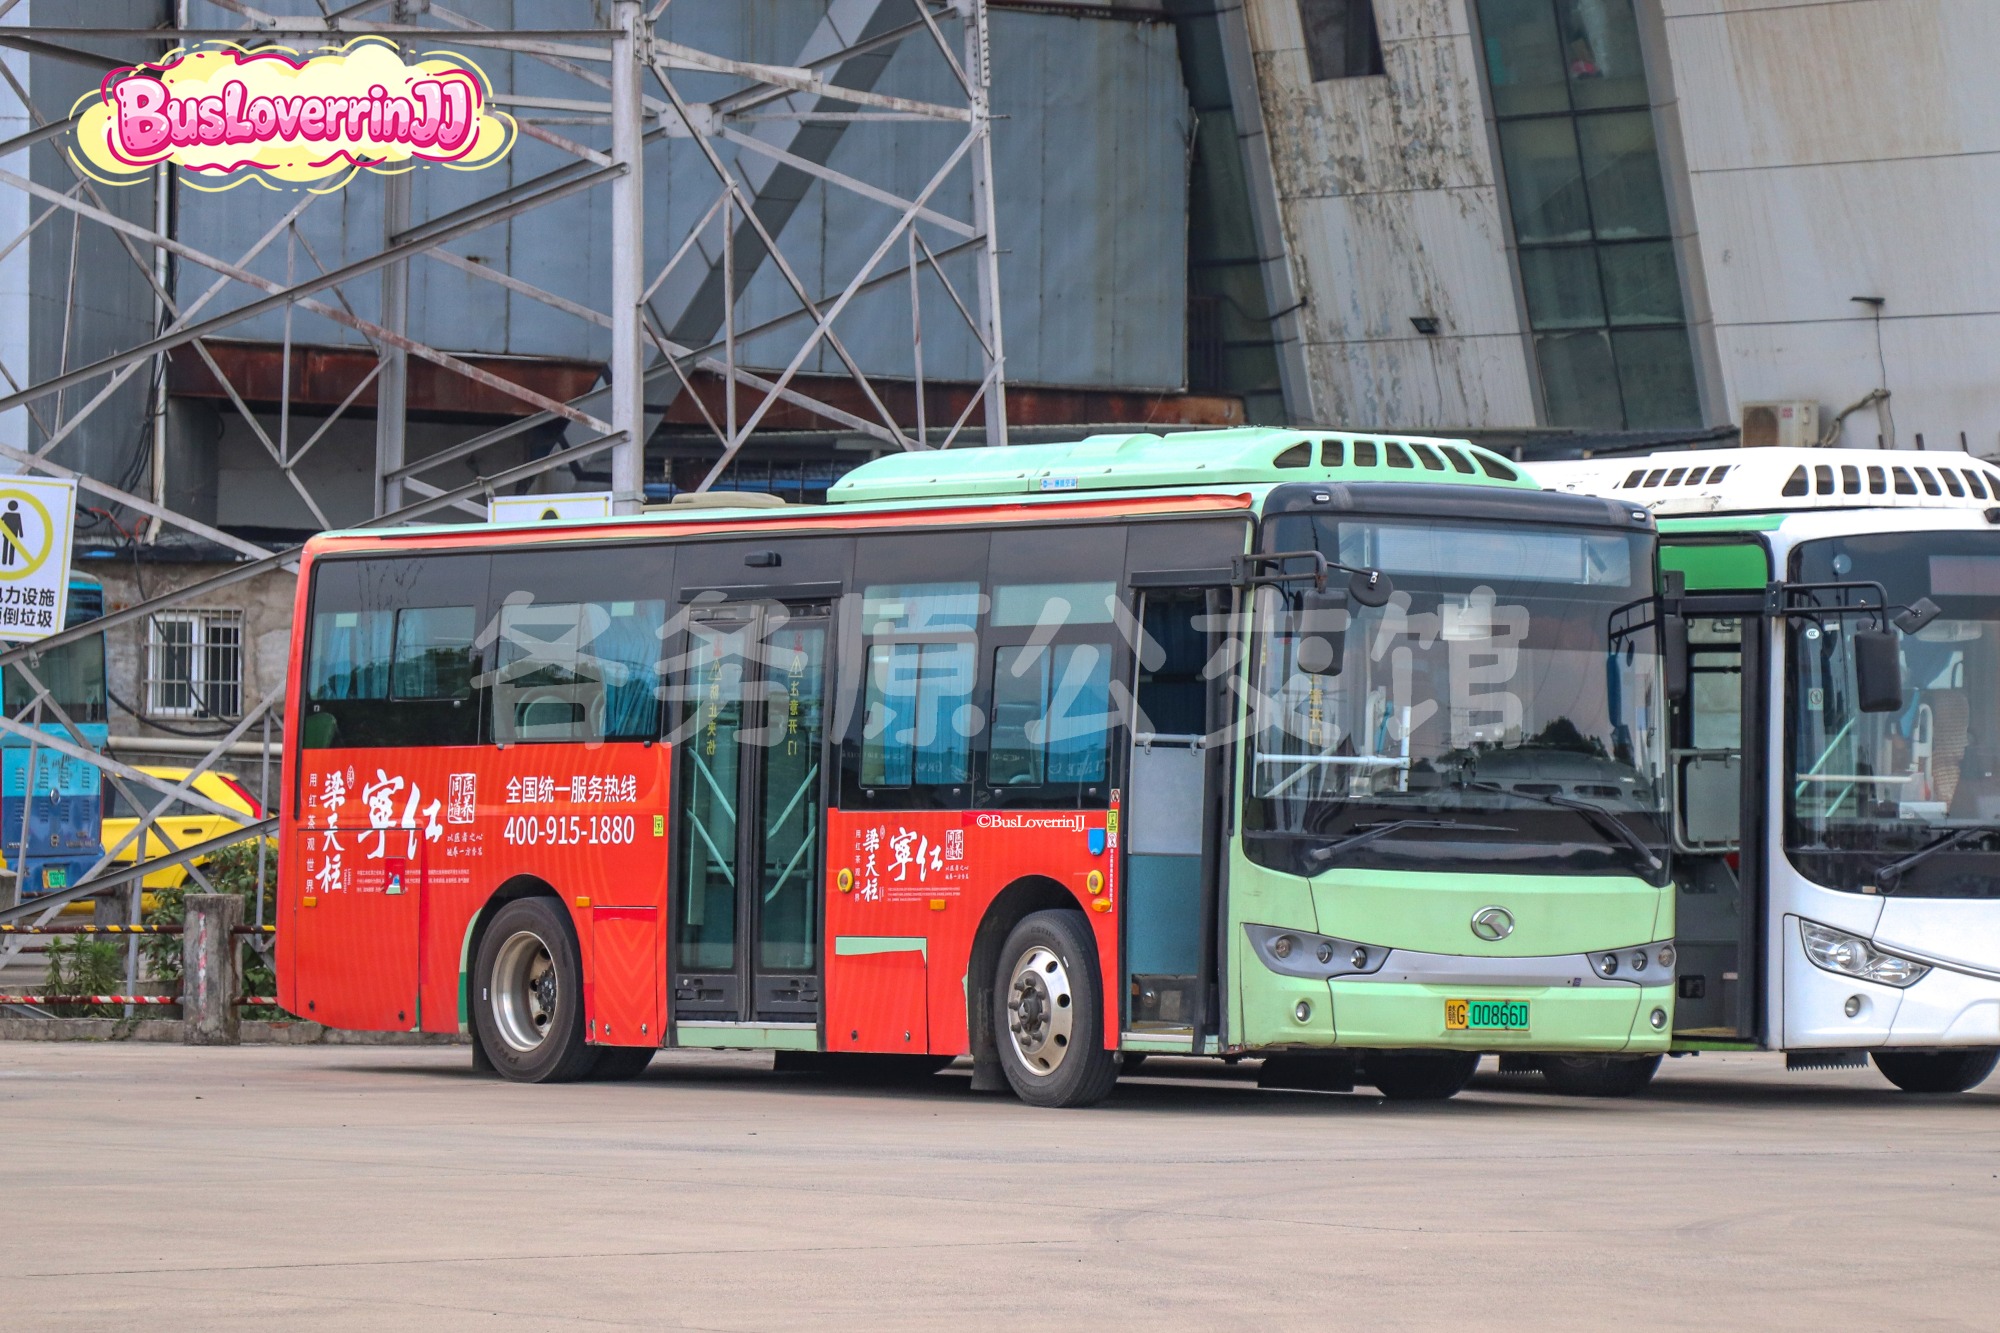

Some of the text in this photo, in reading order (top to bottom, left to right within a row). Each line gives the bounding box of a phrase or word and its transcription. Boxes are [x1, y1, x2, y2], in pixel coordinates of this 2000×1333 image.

[0, 586, 55, 607] 力设施
[0, 607, 52, 628] 倒垃圾
[506, 775, 636, 803] 全国统一服务热线
[504, 815, 635, 845] 400-915-1880
